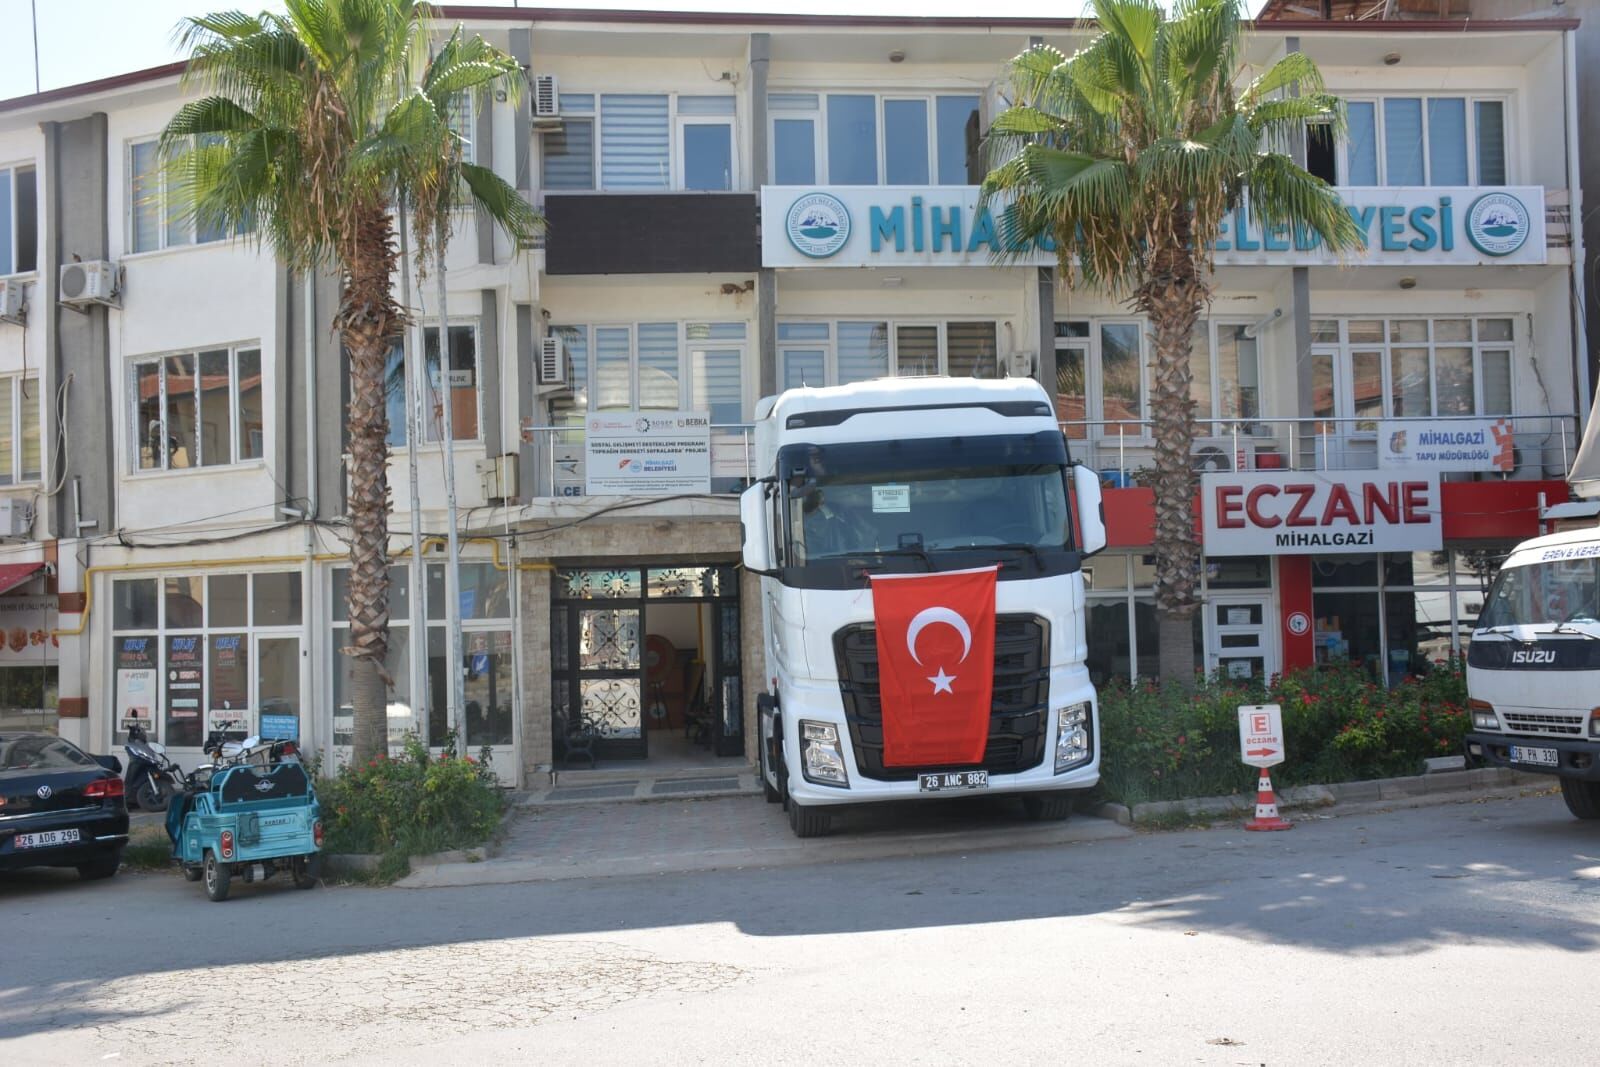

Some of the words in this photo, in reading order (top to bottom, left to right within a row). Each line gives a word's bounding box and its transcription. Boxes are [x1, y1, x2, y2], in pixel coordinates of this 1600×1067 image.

[1419, 429, 1485, 445] MİHALGAZİ
[1416, 452, 1437, 461] TAPU
[1439, 449, 1489, 460] MÜDÜRLÜĞÜ
[1215, 481, 1431, 529] ECZANE
[1275, 529, 1374, 547] MİHALGAZİ
[1512, 651, 1556, 663] ISUZU
[1254, 716, 1267, 732] E
[1543, 750, 1557, 762] 330
[925, 776, 938, 788] 26
[944, 774, 962, 787] ANC
[967, 773, 986, 785] 882
[22, 835, 33, 846] 26
[61, 830, 78, 841] 299
